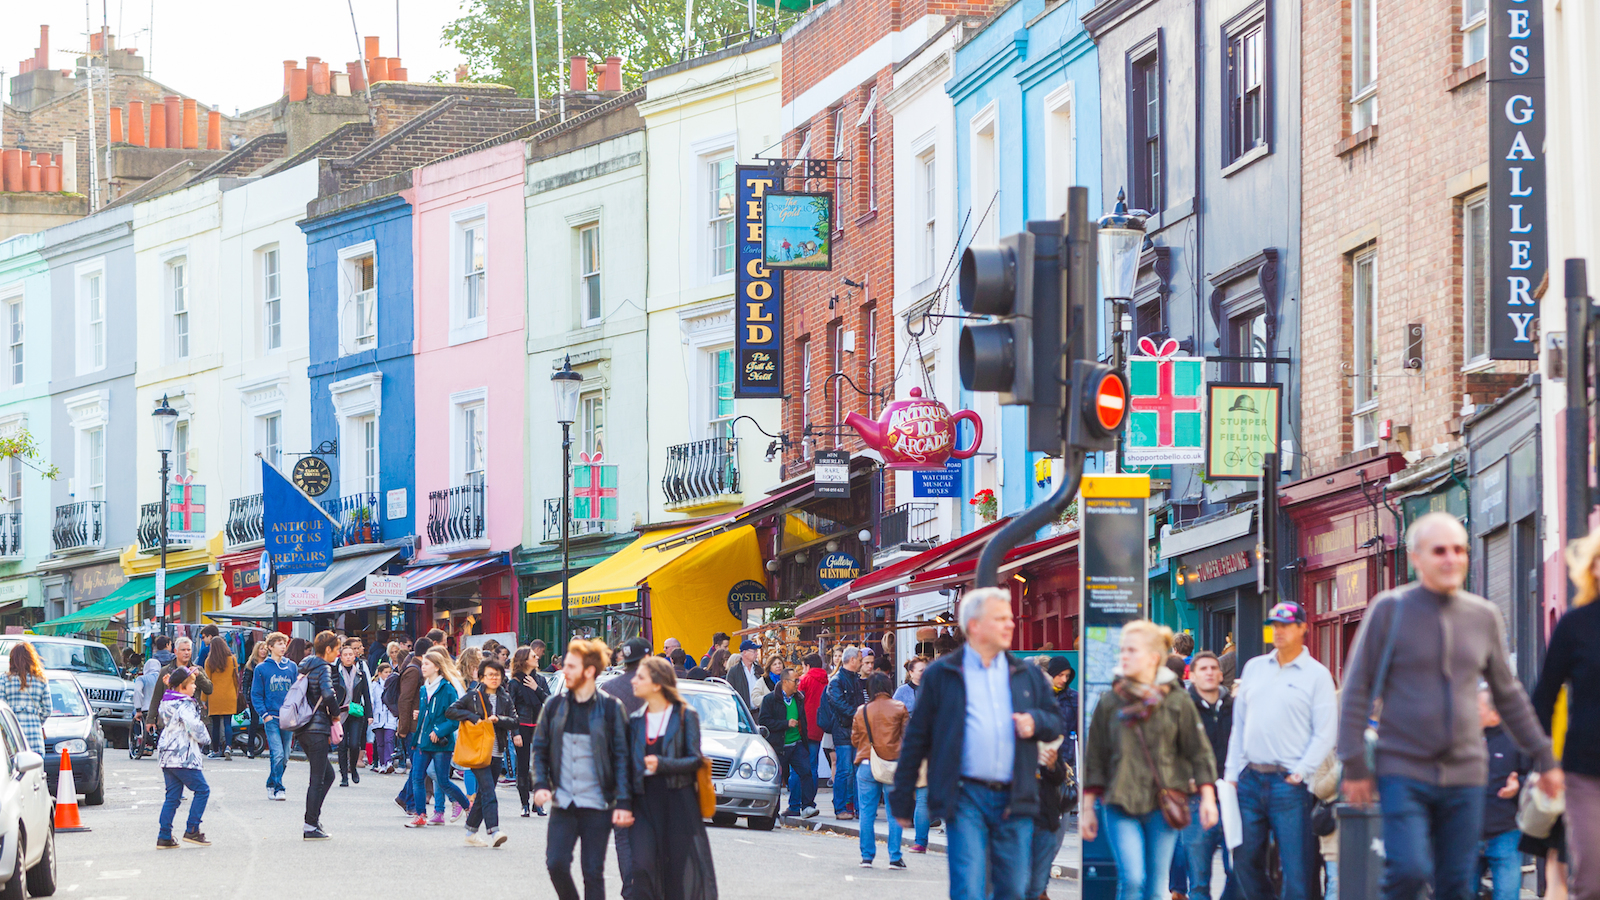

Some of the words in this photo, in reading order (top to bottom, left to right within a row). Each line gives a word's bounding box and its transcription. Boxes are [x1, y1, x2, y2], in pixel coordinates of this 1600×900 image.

[1508, 0, 1532, 76] ES
[779, 207, 802, 223] Gold
[1504, 95, 1536, 343] GALLERY
[746, 258, 773, 344] GOLD
[752, 352, 770, 362] Pub
[745, 361, 765, 373] Grill
[765, 361, 775, 371] &
[747, 371, 773, 381] Hotel
[887, 403, 951, 436] ANTIQUE
[1219, 417, 1267, 426] STUMPER
[917, 421, 937, 437] 101
[892, 430, 951, 457] ARCADE
[1220, 433, 1268, 442] FIELDING
[1127, 453, 1202, 462] shopportobello.co.uk
[271, 520, 325, 532] ANTIQUE
[275, 532, 322, 544] CLOCKS
[294, 543, 304, 552] &
[274, 550, 326, 563] REPAIRS
[826, 555, 854, 570] Gallery
[820, 568, 860, 579] GUESTHOUSE
[369, 588, 404, 596] CASHMERE
[730, 592, 767, 602] OYSTER
[581, 594, 601, 605] BAZAAR
